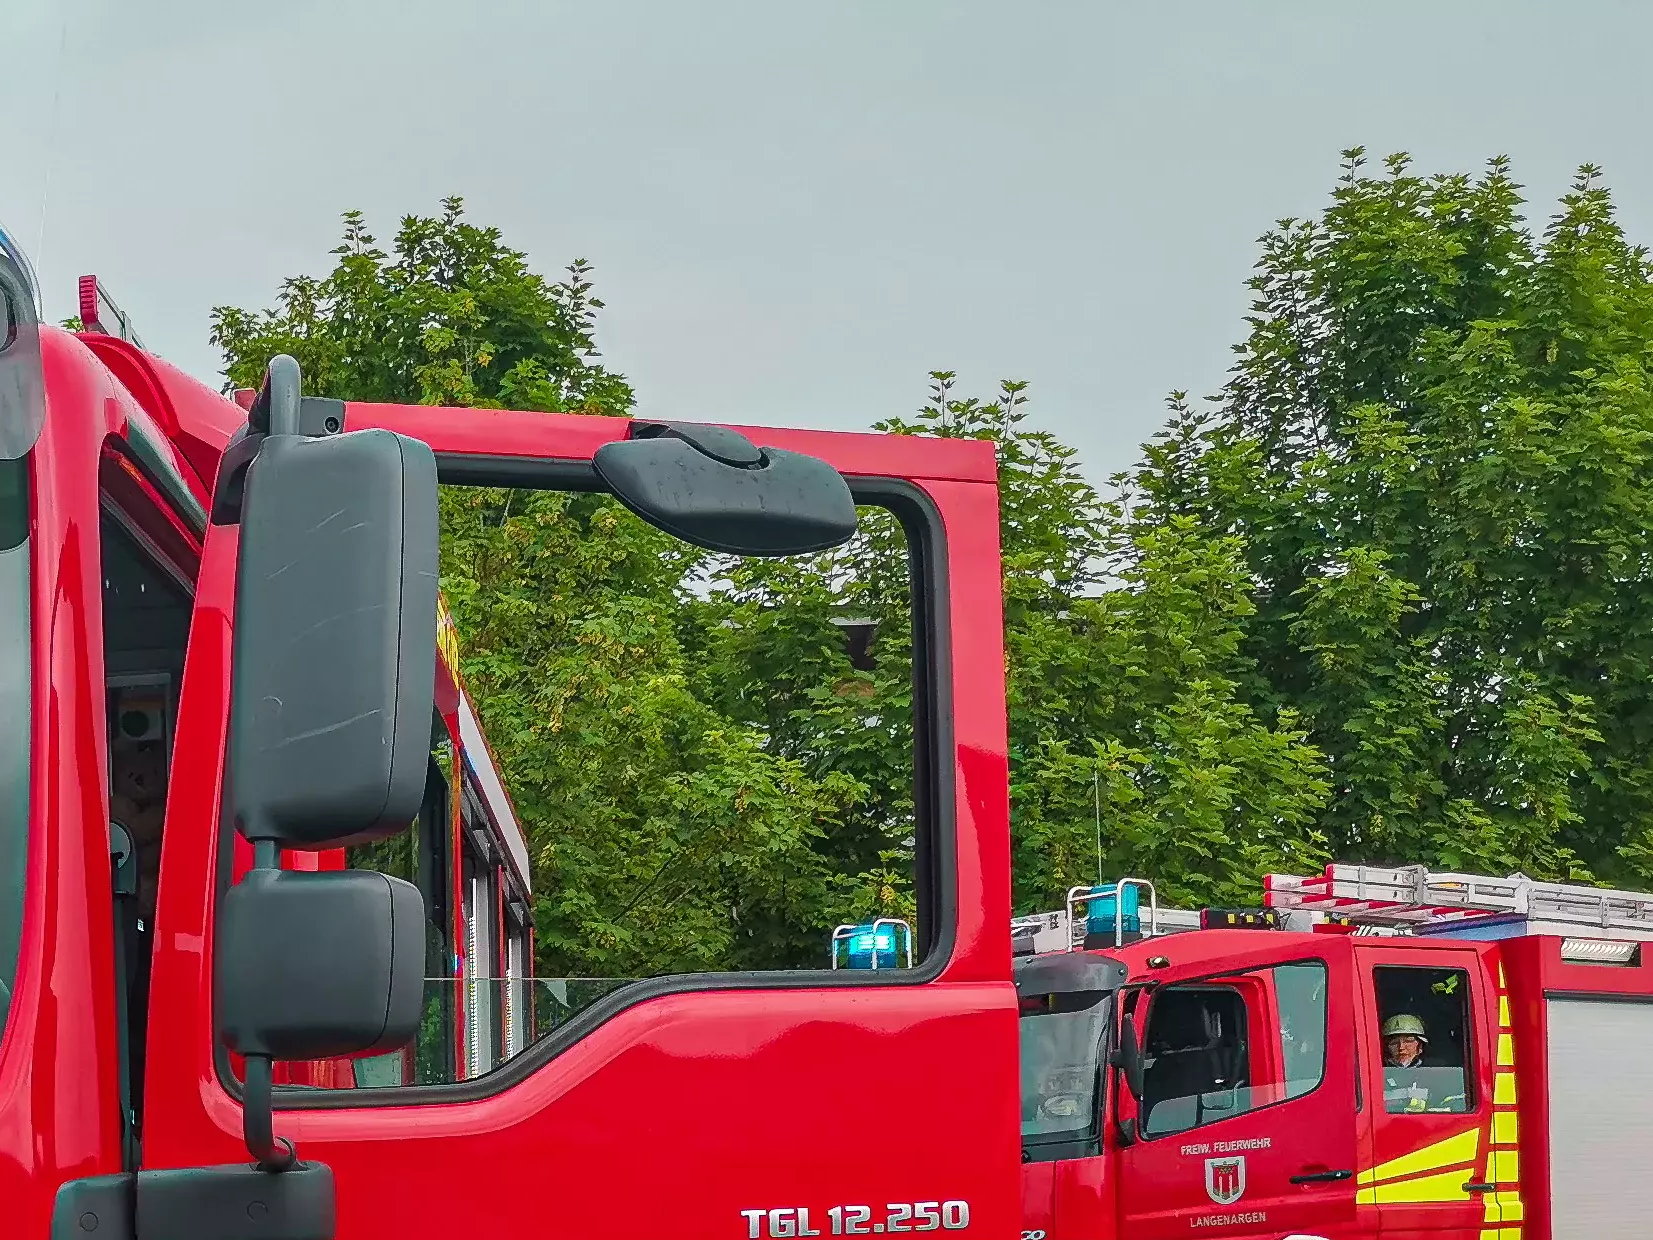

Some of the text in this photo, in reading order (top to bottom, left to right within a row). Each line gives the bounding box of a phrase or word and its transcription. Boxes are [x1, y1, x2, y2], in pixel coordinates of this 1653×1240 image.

[1181, 1137, 1272, 1156] FREIW. FEUERWEHR
[741, 1200, 970, 1239] TGL 12.250
[1190, 1212, 1267, 1228] LANGENARGEN
